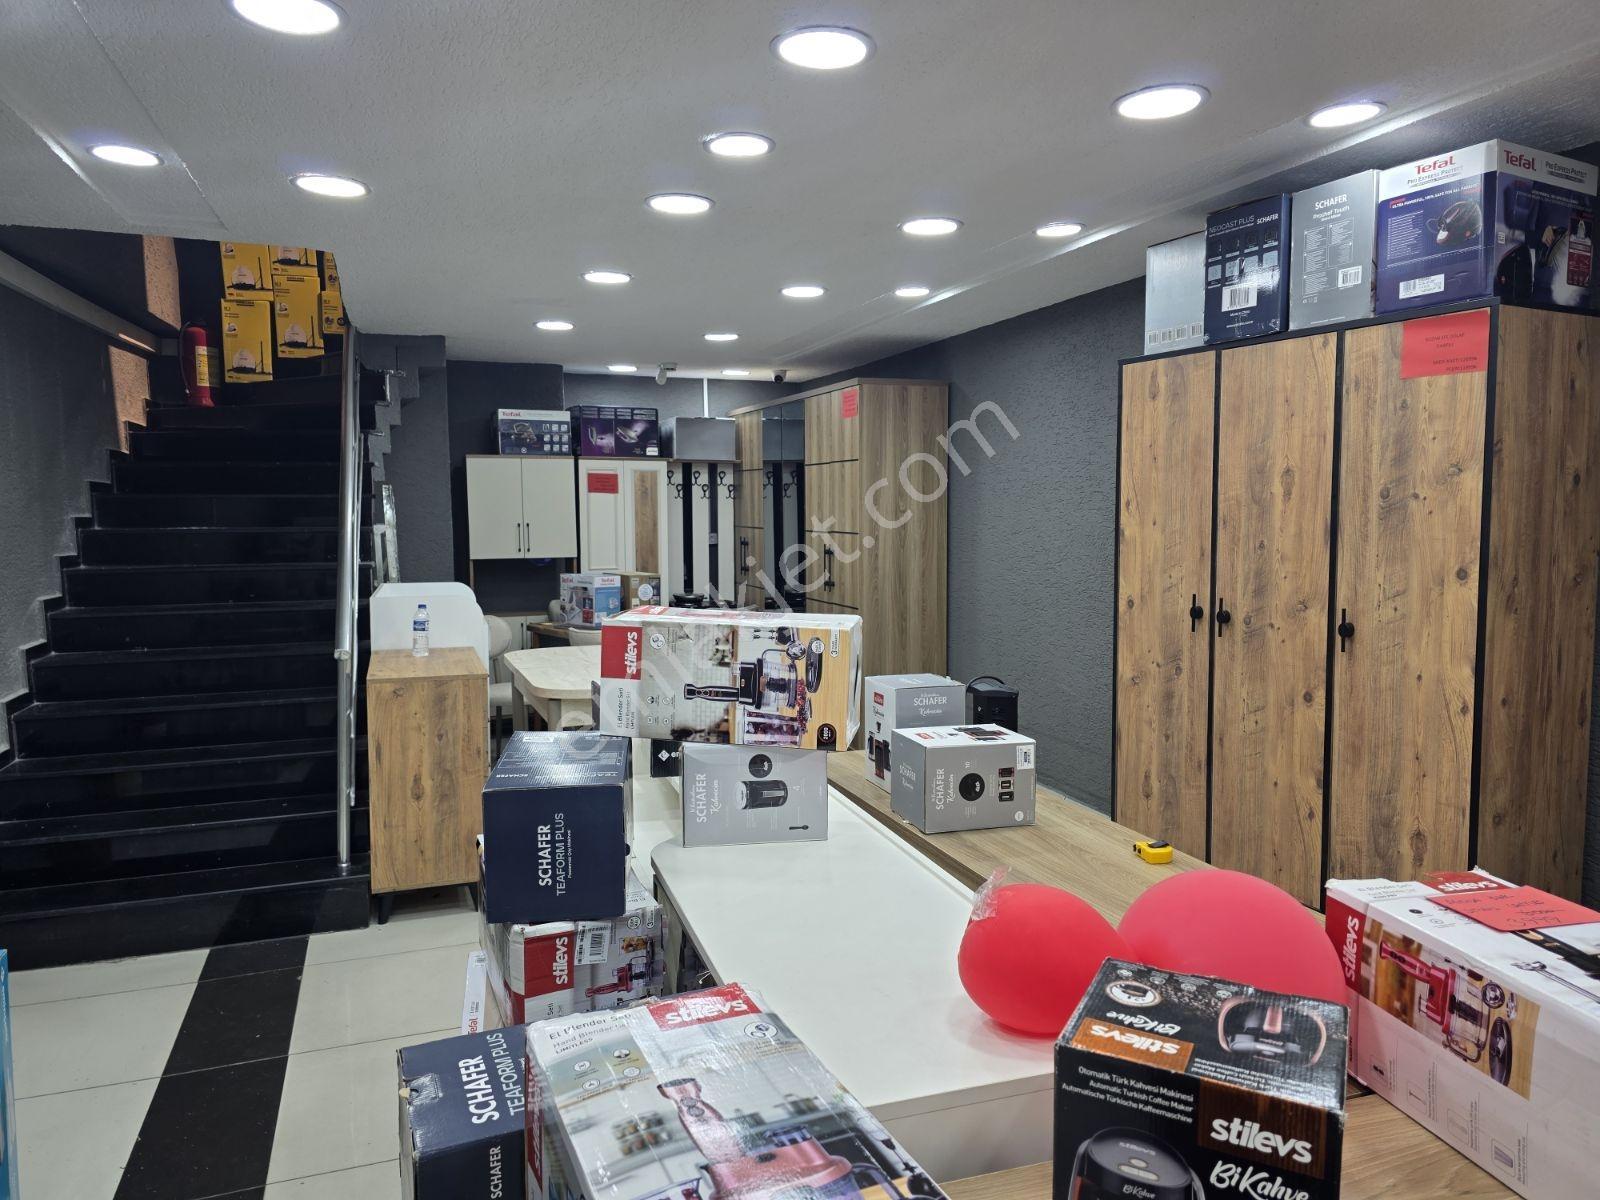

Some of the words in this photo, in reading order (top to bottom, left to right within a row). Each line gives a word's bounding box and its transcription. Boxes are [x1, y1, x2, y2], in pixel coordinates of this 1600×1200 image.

[1415, 156, 1456, 175] Tefal
[1504, 150, 1537, 172] Tefal
[1256, 213, 1279, 225] SCHAFER
[1315, 194, 1348, 210] SCHAFER
[1209, 219, 1238, 234] NEOCAST
[1238, 215, 1255, 226] PLUS
[624, 631, 638, 675] stilevs
[914, 696, 947, 706] SCHAFER
[696, 773, 708, 823] SCHAFER
[936, 768, 945, 810] SCHAFER
[554, 813, 565, 840] PLUS
[538, 824, 552, 886] SCHAFER
[555, 842, 566, 896] TEAFORM
[1437, 879, 1498, 892] stilevs
[553, 936, 568, 984] stilevs
[1343, 915, 1359, 982] stilevs
[666, 998, 748, 1025] stilevs
[486, 1032, 509, 1059] PLUS
[1091, 1025, 1181, 1055] stilevs
[458, 1054, 500, 1125] SCHAFER
[494, 1056, 526, 1117] TEAFORM
[1078, 1066, 1111, 1081] Otomatik
[1112, 1074, 1129, 1086] Türk
[1130, 1079, 1159, 1093] Kahvesi
[1160, 1086, 1194, 1102] Makinesi
[1089, 1080, 1122, 1095] Automatic
[1123, 1088, 1148, 1102] Turkish
[1148, 1095, 1170, 1107] Coffee
[1170, 1100, 1194, 1112] Maker
[1062, 1082, 1105, 1100] Automatische
[1106, 1094, 1138, 1109] Türkische
[1138, 1103, 1193, 1123] Kaffeemaschine
[1210, 1117, 1312, 1164] stilevs
[490, 1146, 502, 1200] SCHAFER
